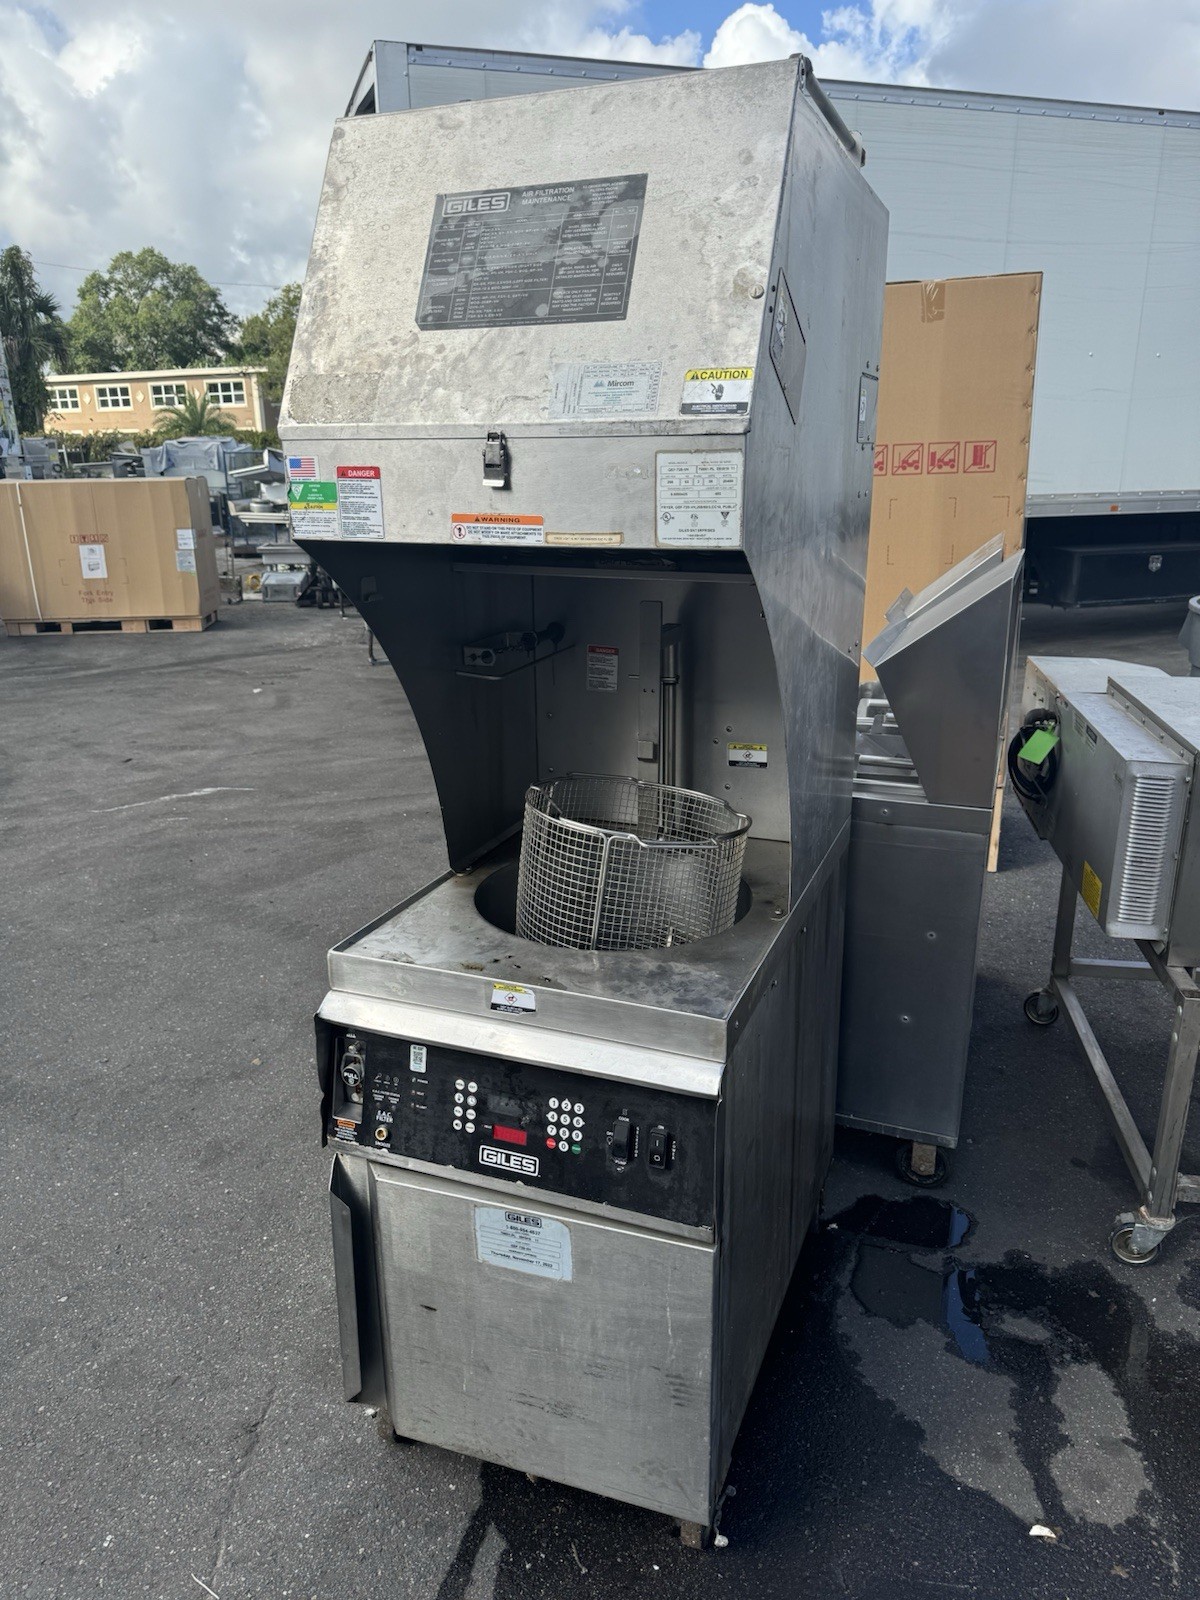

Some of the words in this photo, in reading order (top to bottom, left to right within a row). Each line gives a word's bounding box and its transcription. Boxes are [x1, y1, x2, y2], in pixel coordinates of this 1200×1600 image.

[534, 186, 576, 196] FILTRATION
[447, 196, 506, 214] GILES
[522, 195, 572, 205] MAINTENANCE
[700, 370, 748, 380] CAUTION
[344, 1072, 359, 1080] PULL
[483, 1150, 536, 1172] GILES
[508, 1214, 540, 1226] GILES
